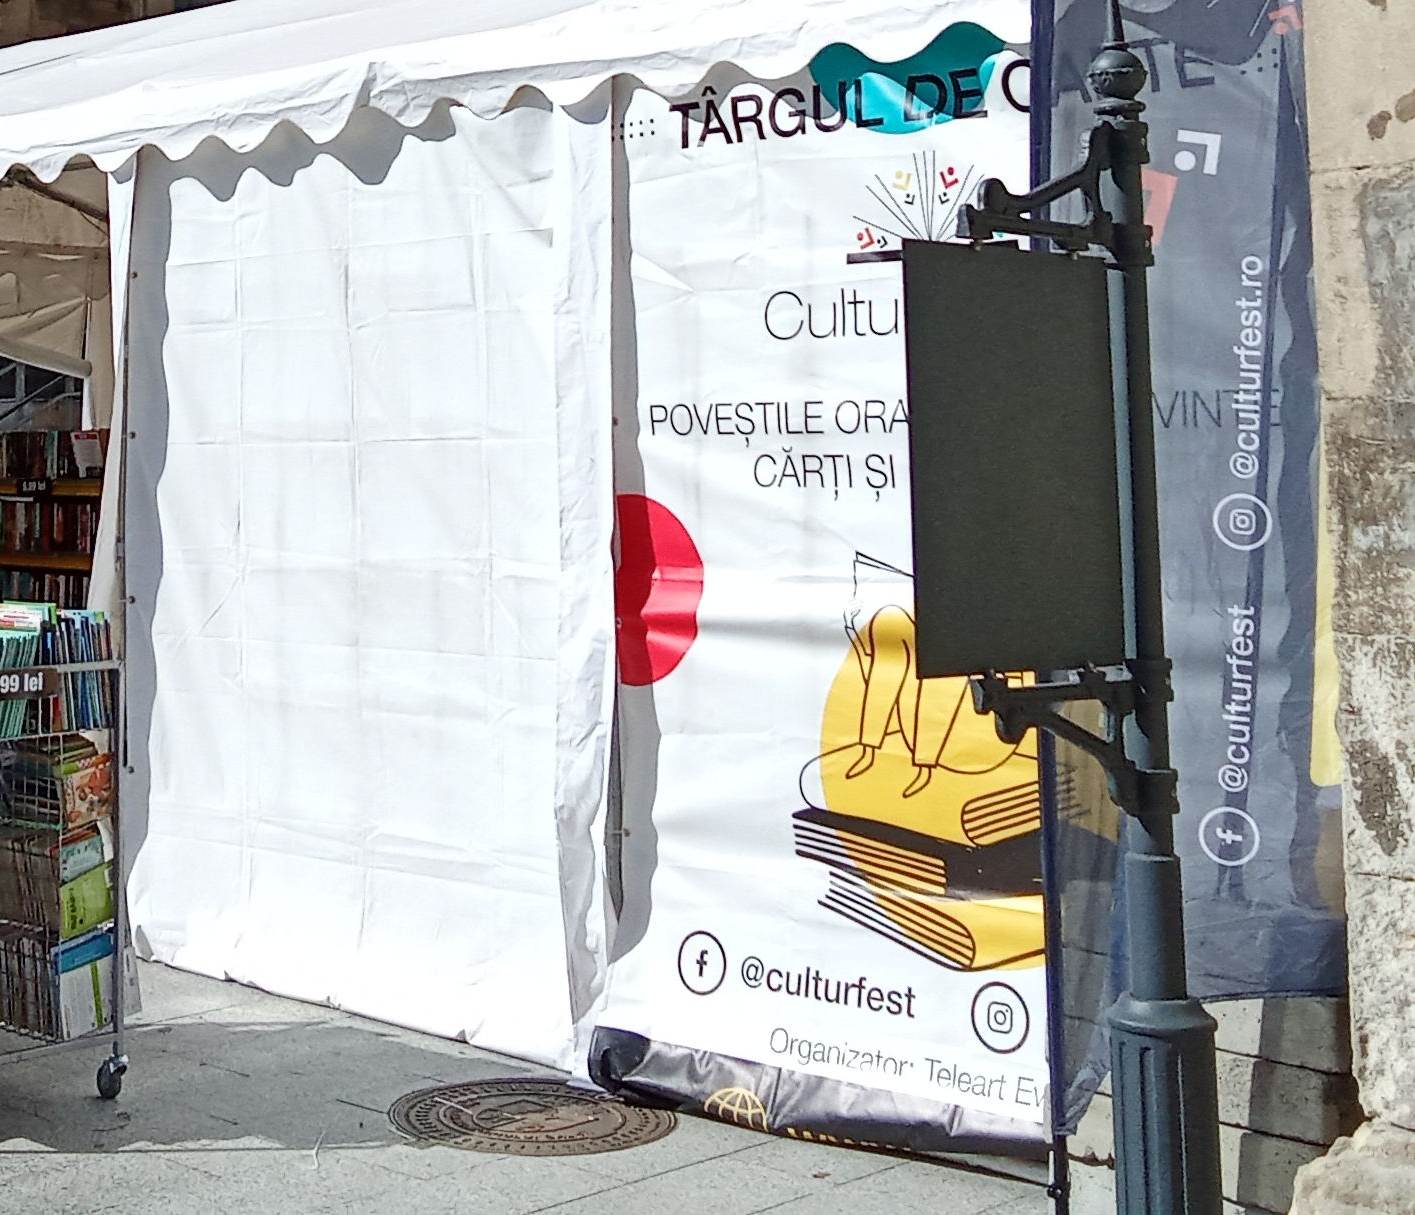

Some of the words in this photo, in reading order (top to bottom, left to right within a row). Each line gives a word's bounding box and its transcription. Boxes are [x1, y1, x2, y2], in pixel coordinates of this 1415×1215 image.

[669, 79, 884, 149] TÂRGUL
[904, 68, 988, 122] DE
[1230, 254, 1265, 481] @culturfest.ro
[649, 400, 824, 447] POVEȘTILE
[753, 445, 852, 501] CĂRȚI
[866, 454, 897, 502] ȘI
[23, 671, 44, 693] lei
[1218, 603, 1255, 794] @culturfest
[740, 954, 916, 1020] @culturfest
[924, 1057, 1007, 1101] Teleart
